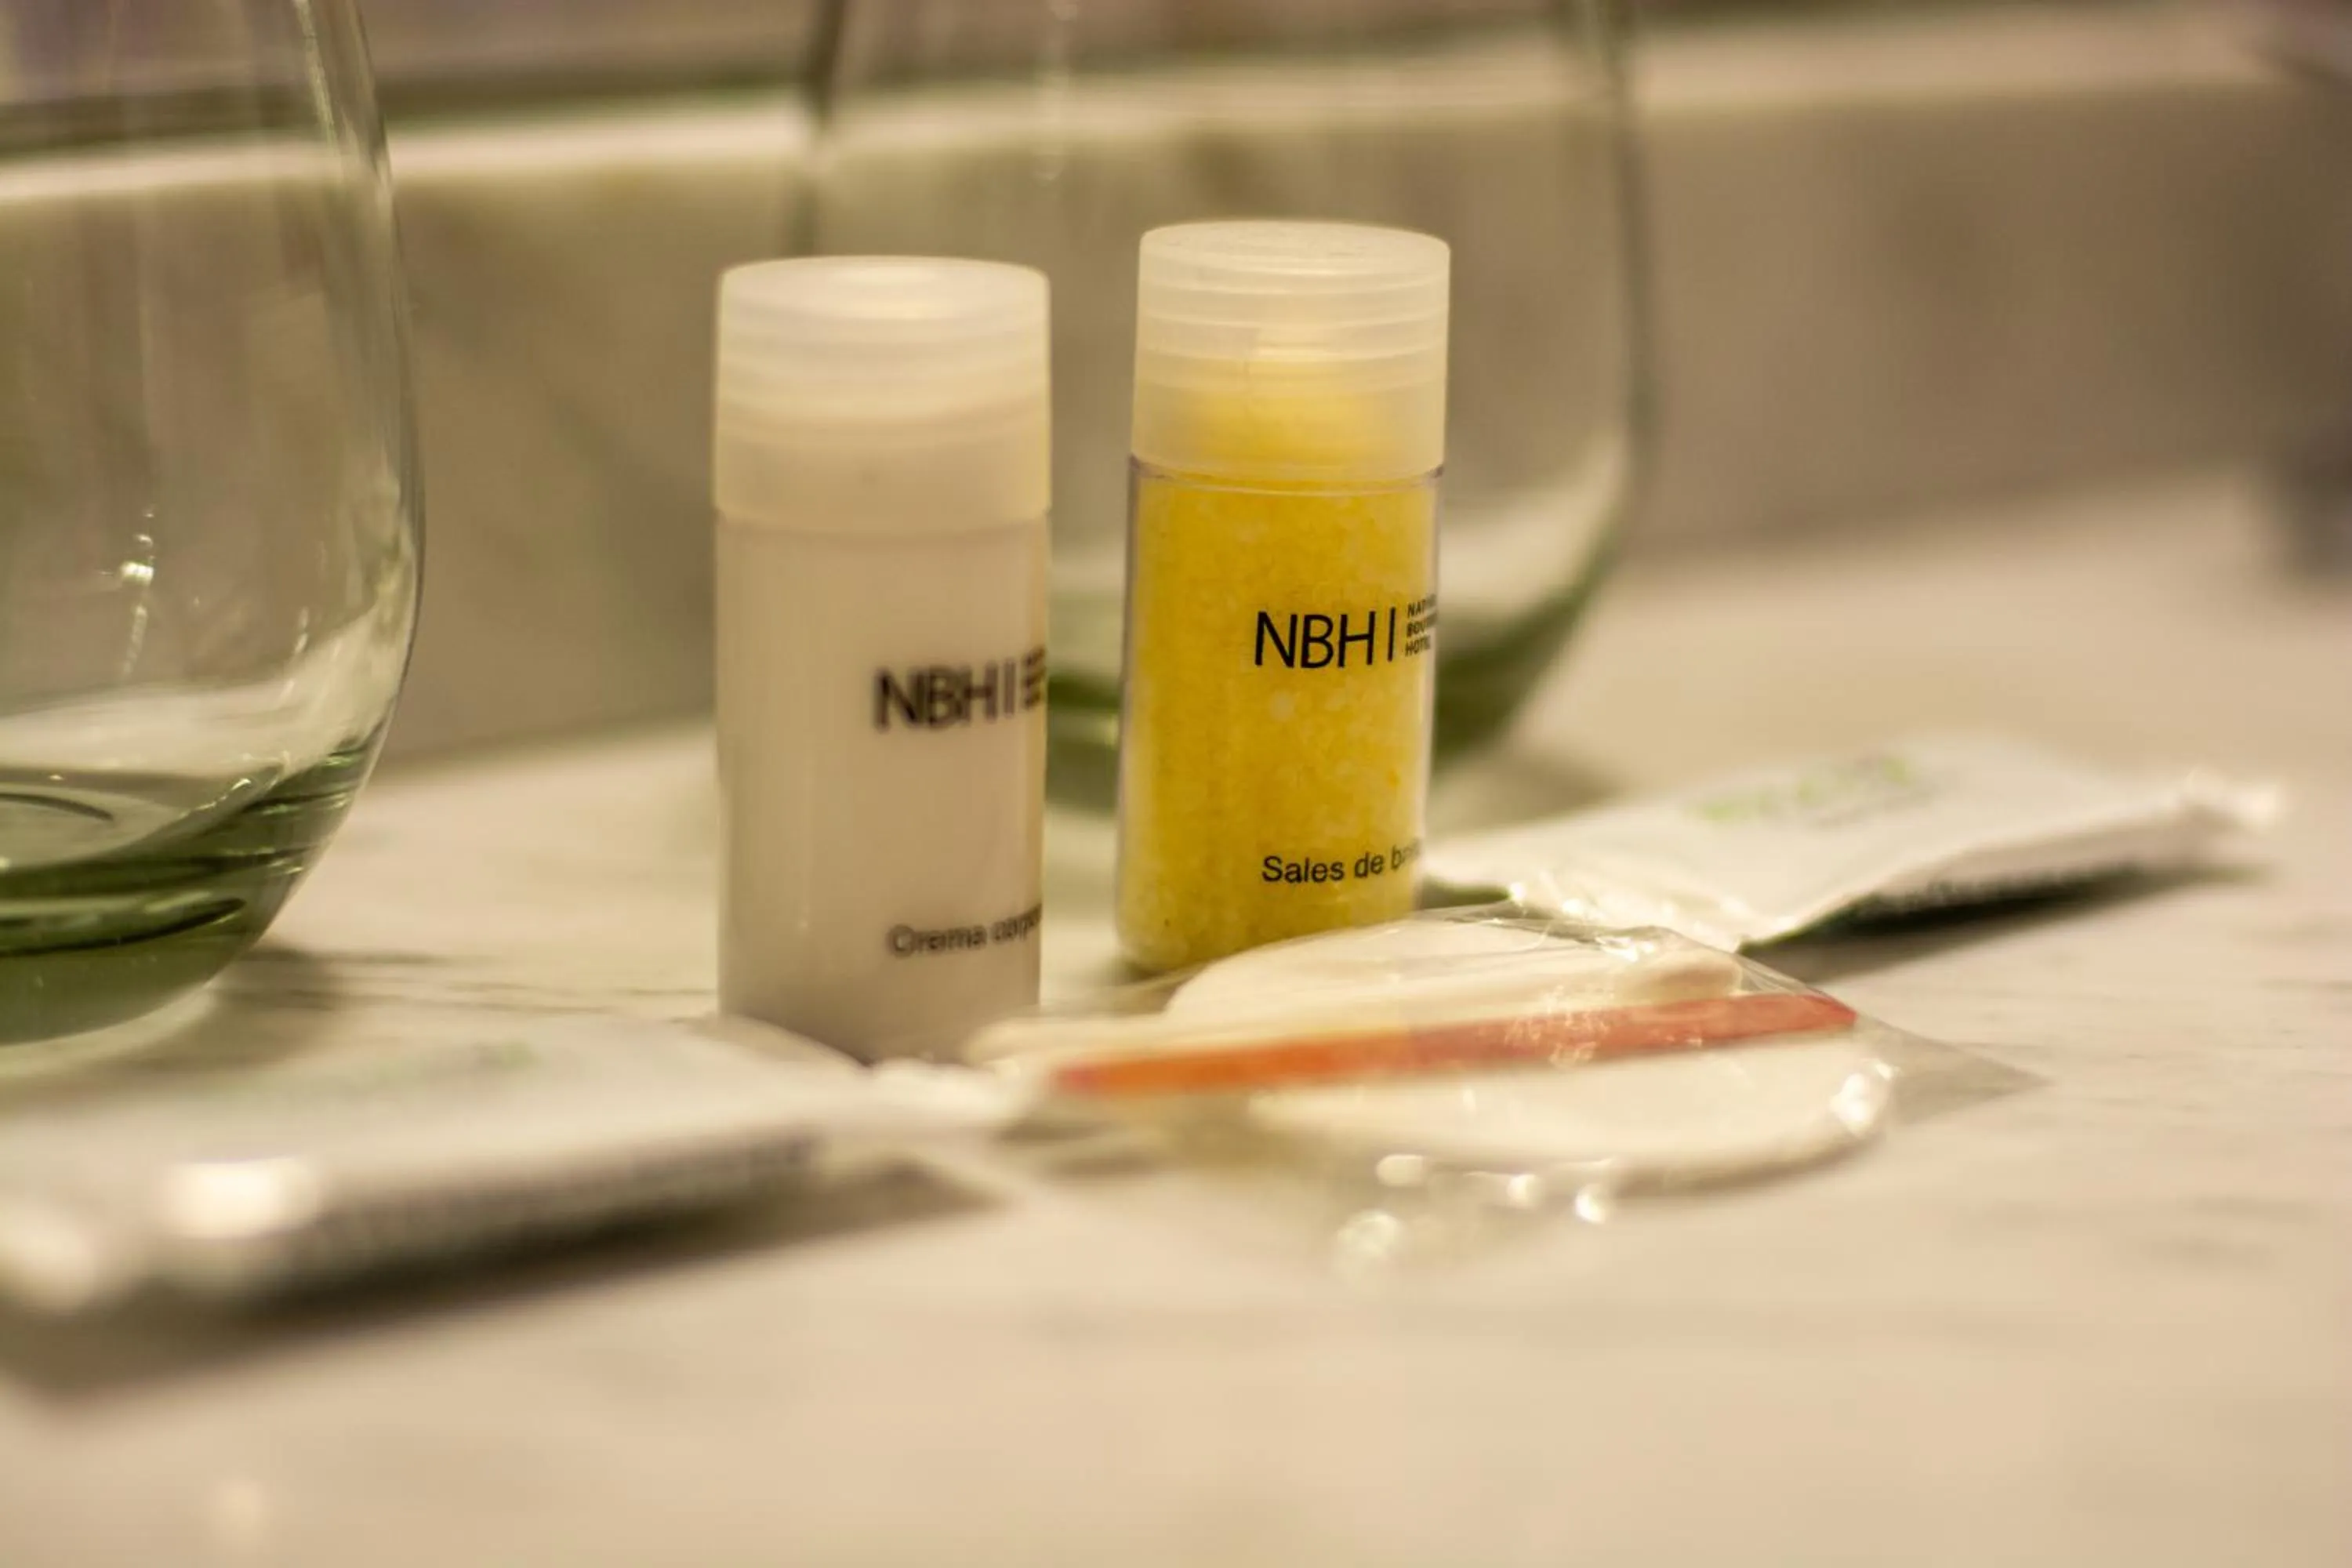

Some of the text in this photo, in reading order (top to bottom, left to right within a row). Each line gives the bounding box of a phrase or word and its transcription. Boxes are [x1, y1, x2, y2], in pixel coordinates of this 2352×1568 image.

[1254, 610, 1376, 668] NBH
[873, 662, 997, 731] NBH
[1261, 855, 1345, 883] Sales
[1354, 851, 1383, 878] de
[887, 924, 987, 957] Crema
